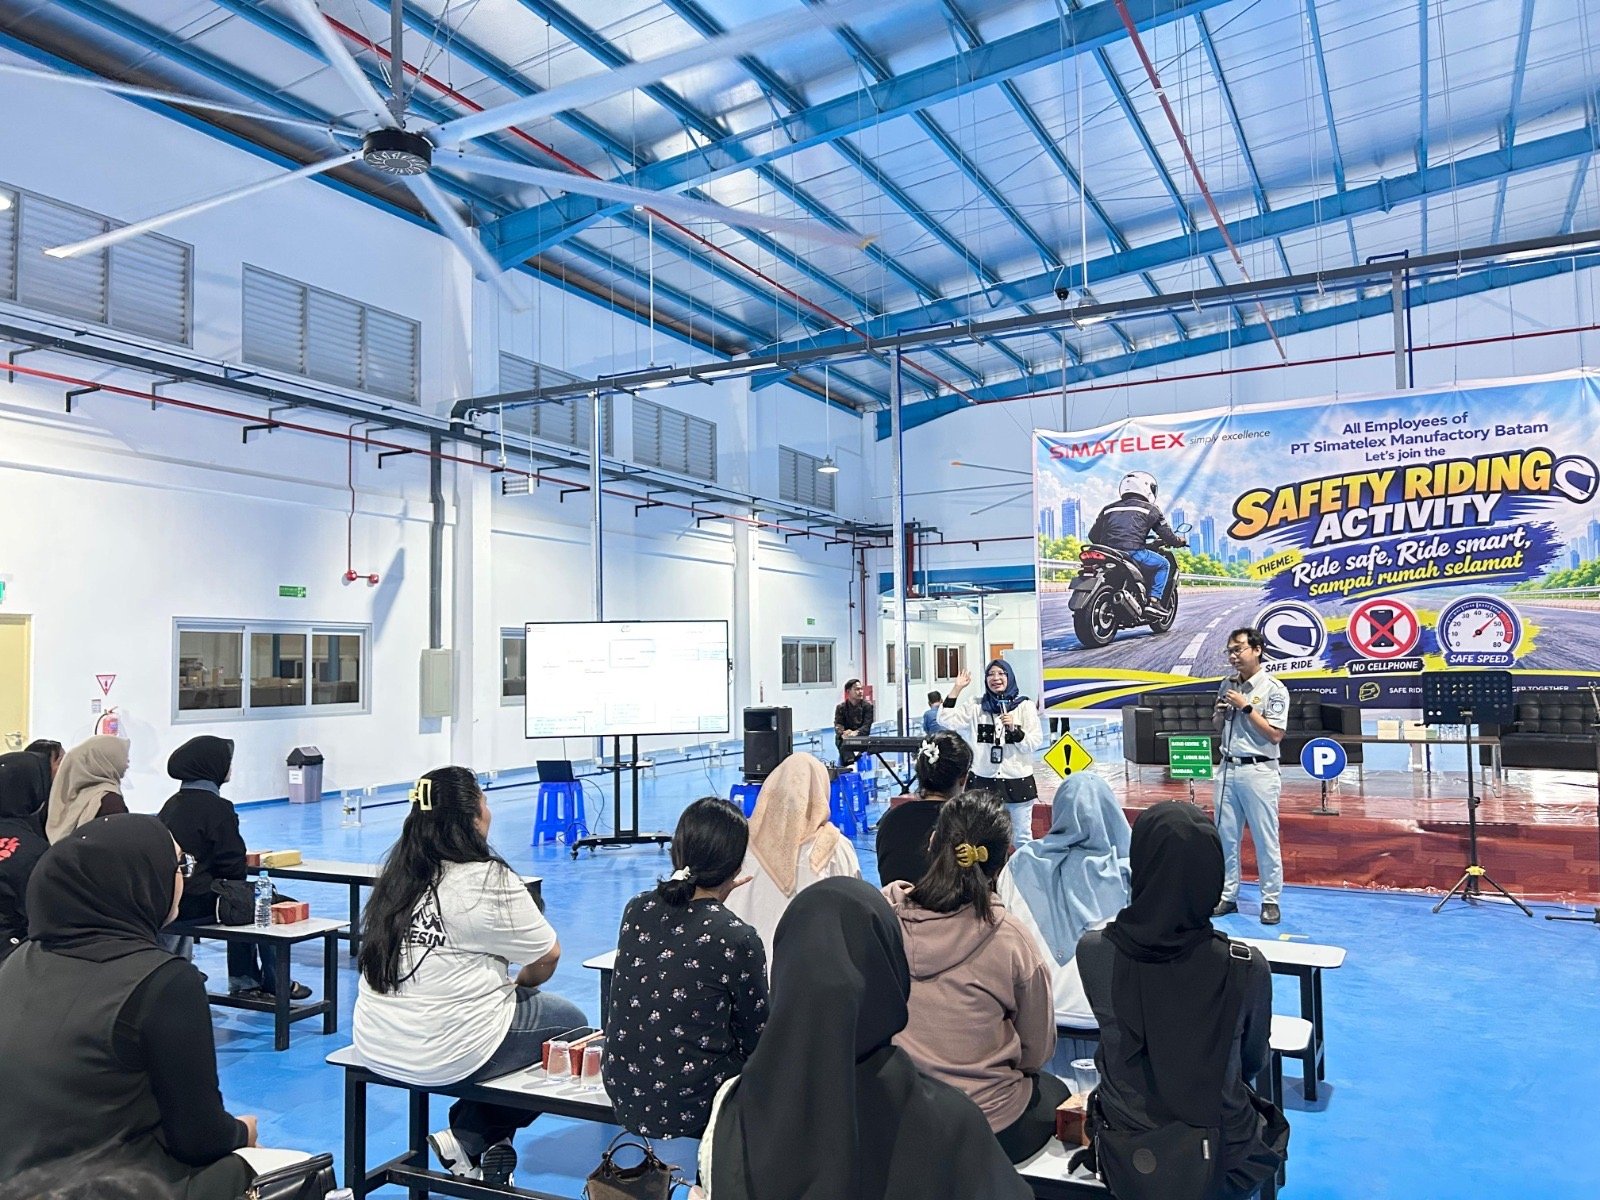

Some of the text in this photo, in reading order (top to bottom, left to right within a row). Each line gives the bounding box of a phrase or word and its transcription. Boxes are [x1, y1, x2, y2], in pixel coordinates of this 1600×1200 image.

[1342, 411, 1469, 435] All Employees of
[1050, 432, 1185, 460] SIMATELEX
[1189, 429, 1271, 447] simply excellence
[1290, 423, 1549, 455] PT Simatelex Manufactory Batam
[1365, 447, 1446, 462] Let's join the
[1230, 450, 1553, 537] SAFETY RIDING
[1312, 493, 1502, 544] ACTIVITY
[1256, 554, 1294, 576] THEME:
[1291, 527, 1531, 588] Ride safe, Ride smart,
[1309, 551, 1523, 597] sampai rumah selamat
[1265, 659, 1313, 673] SAFE RIDE
[1351, 660, 1419, 672] NO CELLPHONE
[1450, 654, 1509, 664] SAFE SPEED
[1313, 746, 1336, 776] P
